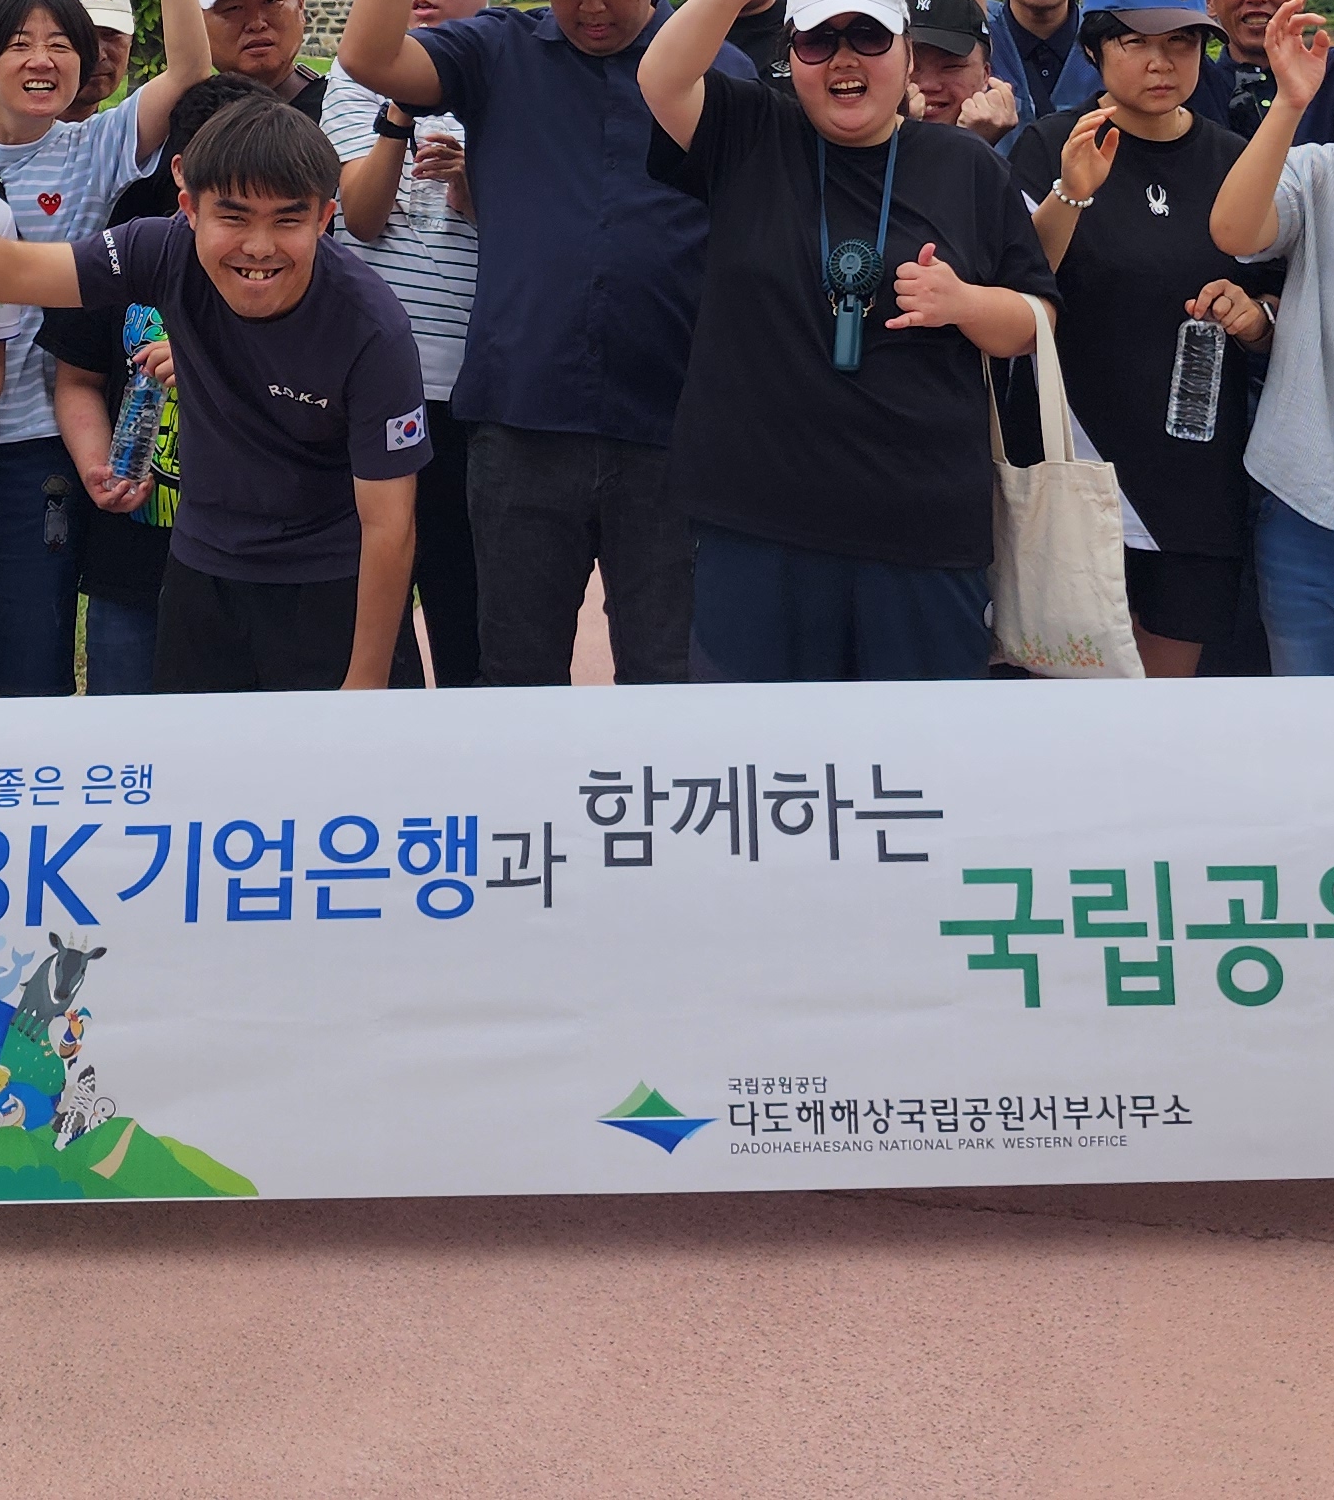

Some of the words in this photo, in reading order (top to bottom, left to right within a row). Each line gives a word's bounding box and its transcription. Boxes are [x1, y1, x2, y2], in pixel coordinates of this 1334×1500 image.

[108, 249, 121, 276] SPORT
[81, 762, 154, 806] 은행
[578, 763, 944, 868] 함께하는
[727, 1076, 828, 1096] 국립공원공단
[727, 1094, 1194, 1136] 다도해해상국립공원서부사무소
[730, 1140, 874, 1155] DADOHAEHAESANG
[879, 1138, 954, 1152] NATIONAL
[958, 1137, 995, 1150] PARK
[1002, 1136, 1073, 1149] WESTERN
[1078, 1134, 1128, 1148] OFFICE
